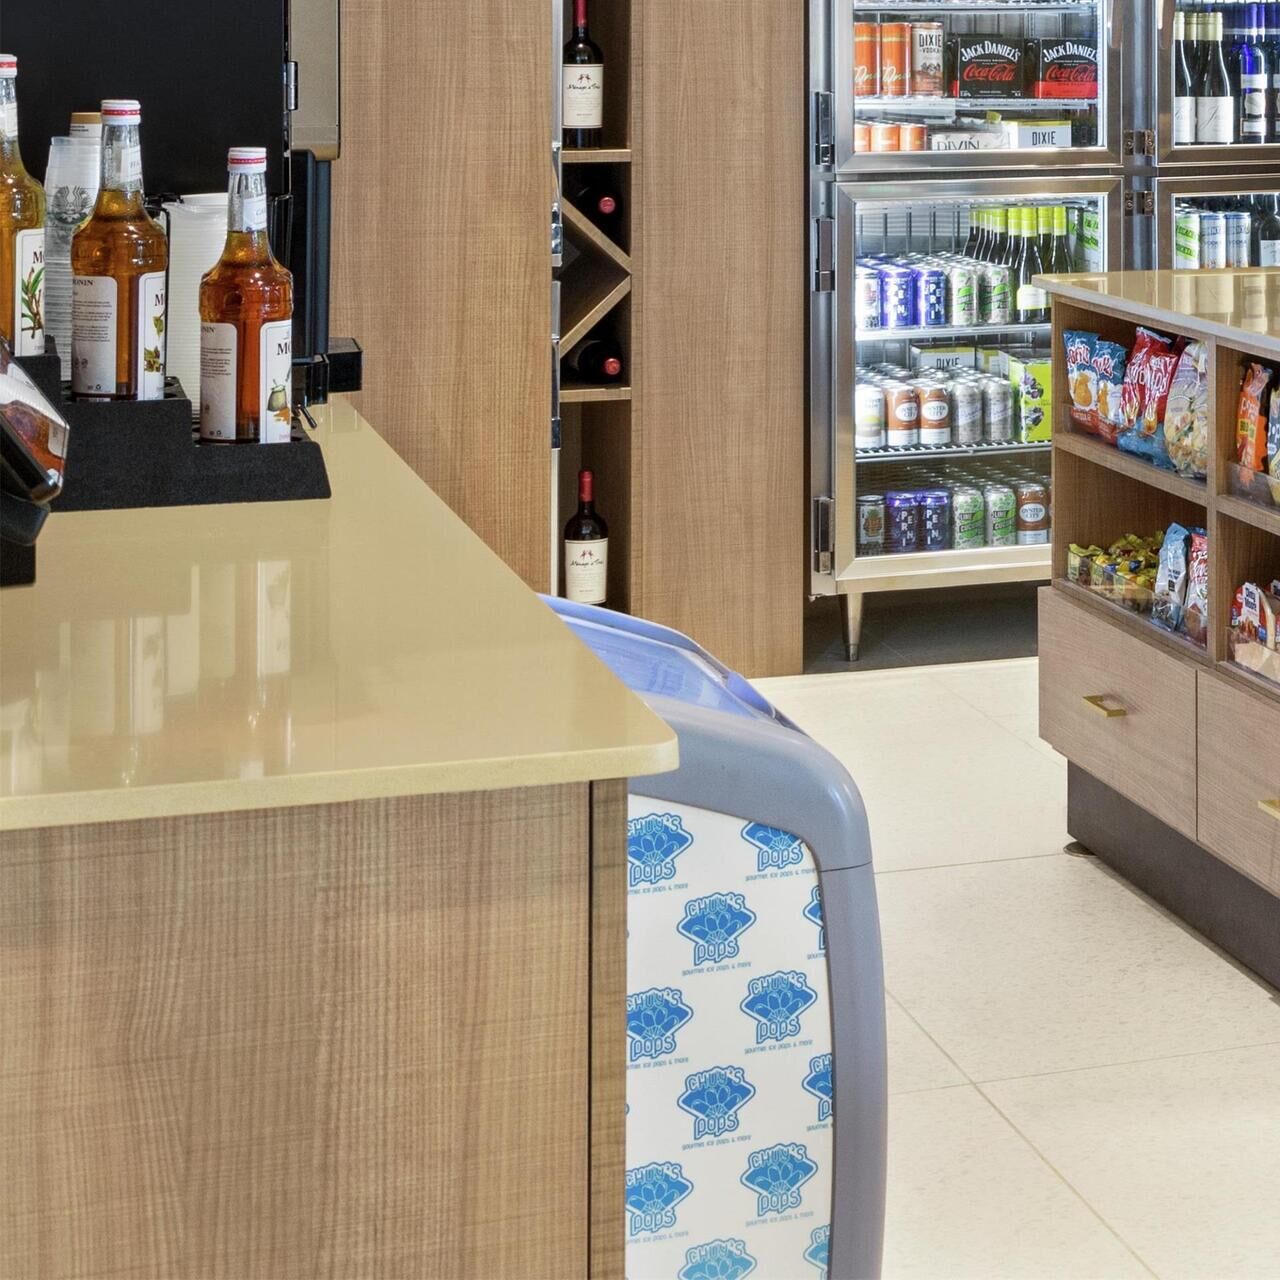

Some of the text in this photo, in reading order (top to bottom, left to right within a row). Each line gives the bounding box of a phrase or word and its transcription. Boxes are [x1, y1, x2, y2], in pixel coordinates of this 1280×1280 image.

[919, 34, 942, 47] DIXIE
[960, 41, 1021, 62] JACK DANIEL'S
[1043, 45, 1066, 63] JACK
[963, 63, 1017, 81] Coca-Cola
[1031, 130, 1057, 146] DIXIE
